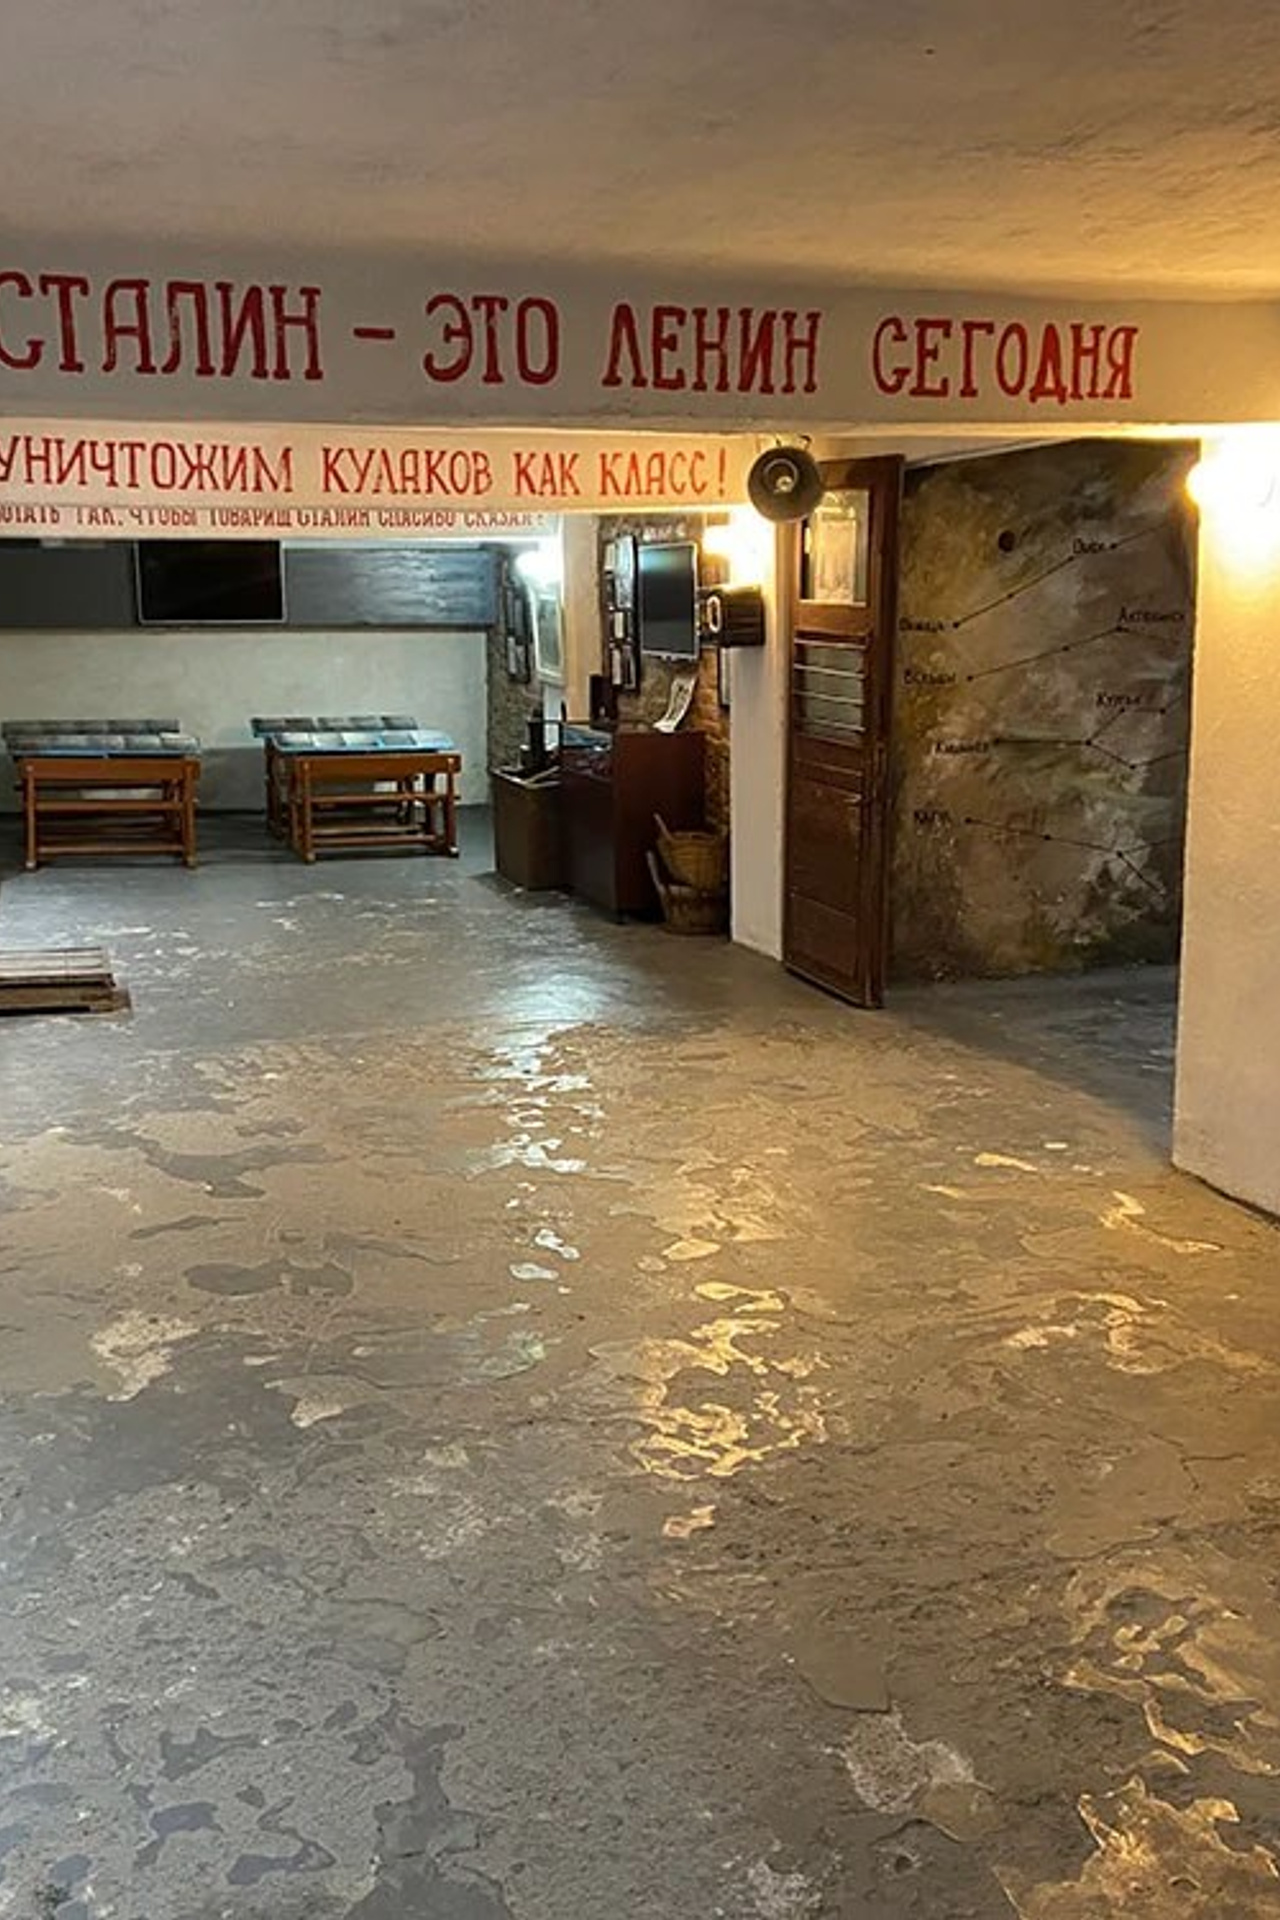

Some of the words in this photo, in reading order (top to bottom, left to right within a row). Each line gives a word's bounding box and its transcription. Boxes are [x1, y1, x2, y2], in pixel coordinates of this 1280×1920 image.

[0, 271, 323, 380] СТАЛИН
[423, 293, 560, 385] ЭТО
[602, 303, 822, 395] ЛЕНИН
[872, 315, 1139, 405] СЕГОДНЯ
[0, 435, 292, 494] УНИЧТОЖИМ
[321, 446, 493, 496] КУЛАКОВ
[515, 452, 581, 497] КАК
[599, 448, 727, 499] КЛАСС!
